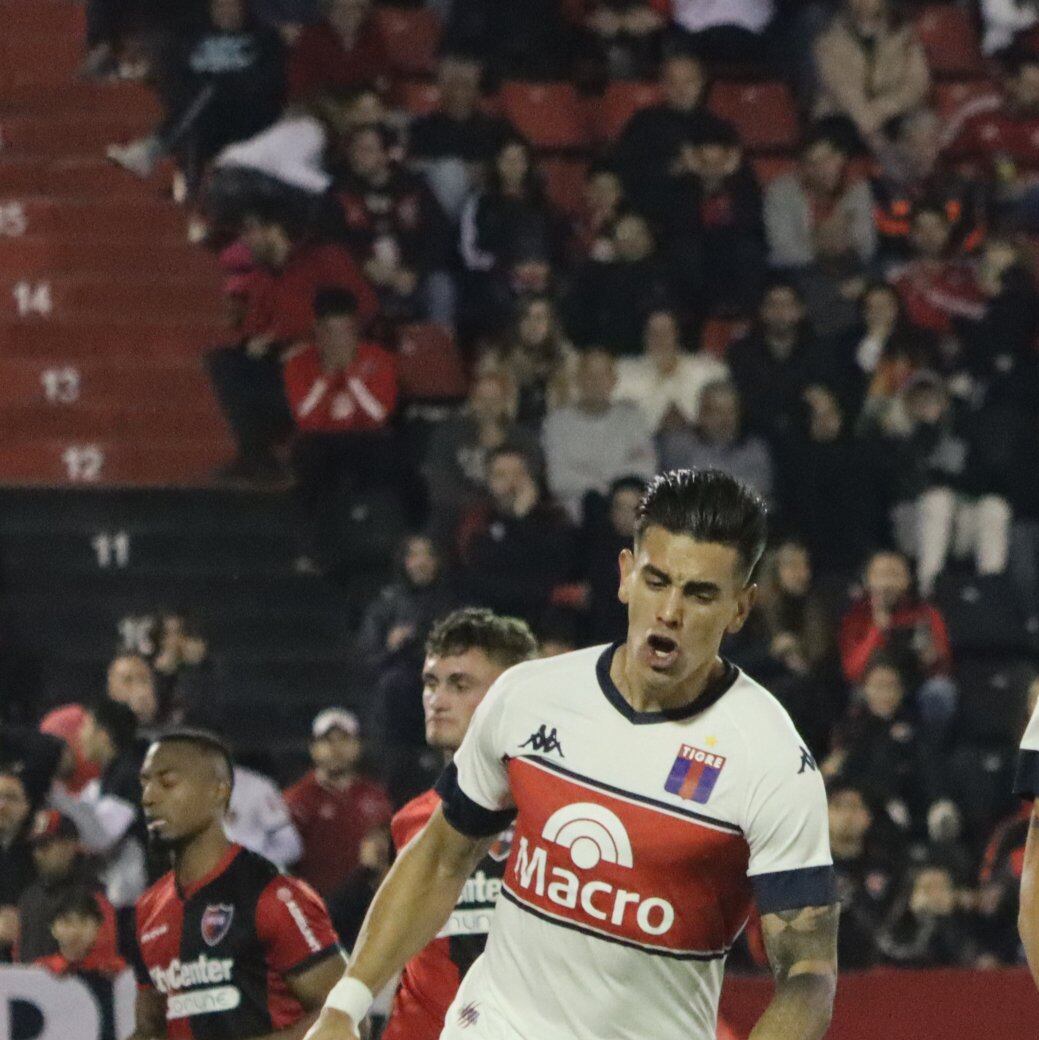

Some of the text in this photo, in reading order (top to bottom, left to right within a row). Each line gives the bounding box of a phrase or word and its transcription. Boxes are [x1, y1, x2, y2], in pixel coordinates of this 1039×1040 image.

[14, 281, 52, 318] 14
[93, 531, 130, 568] 11
[682, 745, 724, 769] TIGRE
[513, 836, 675, 936] Macro
